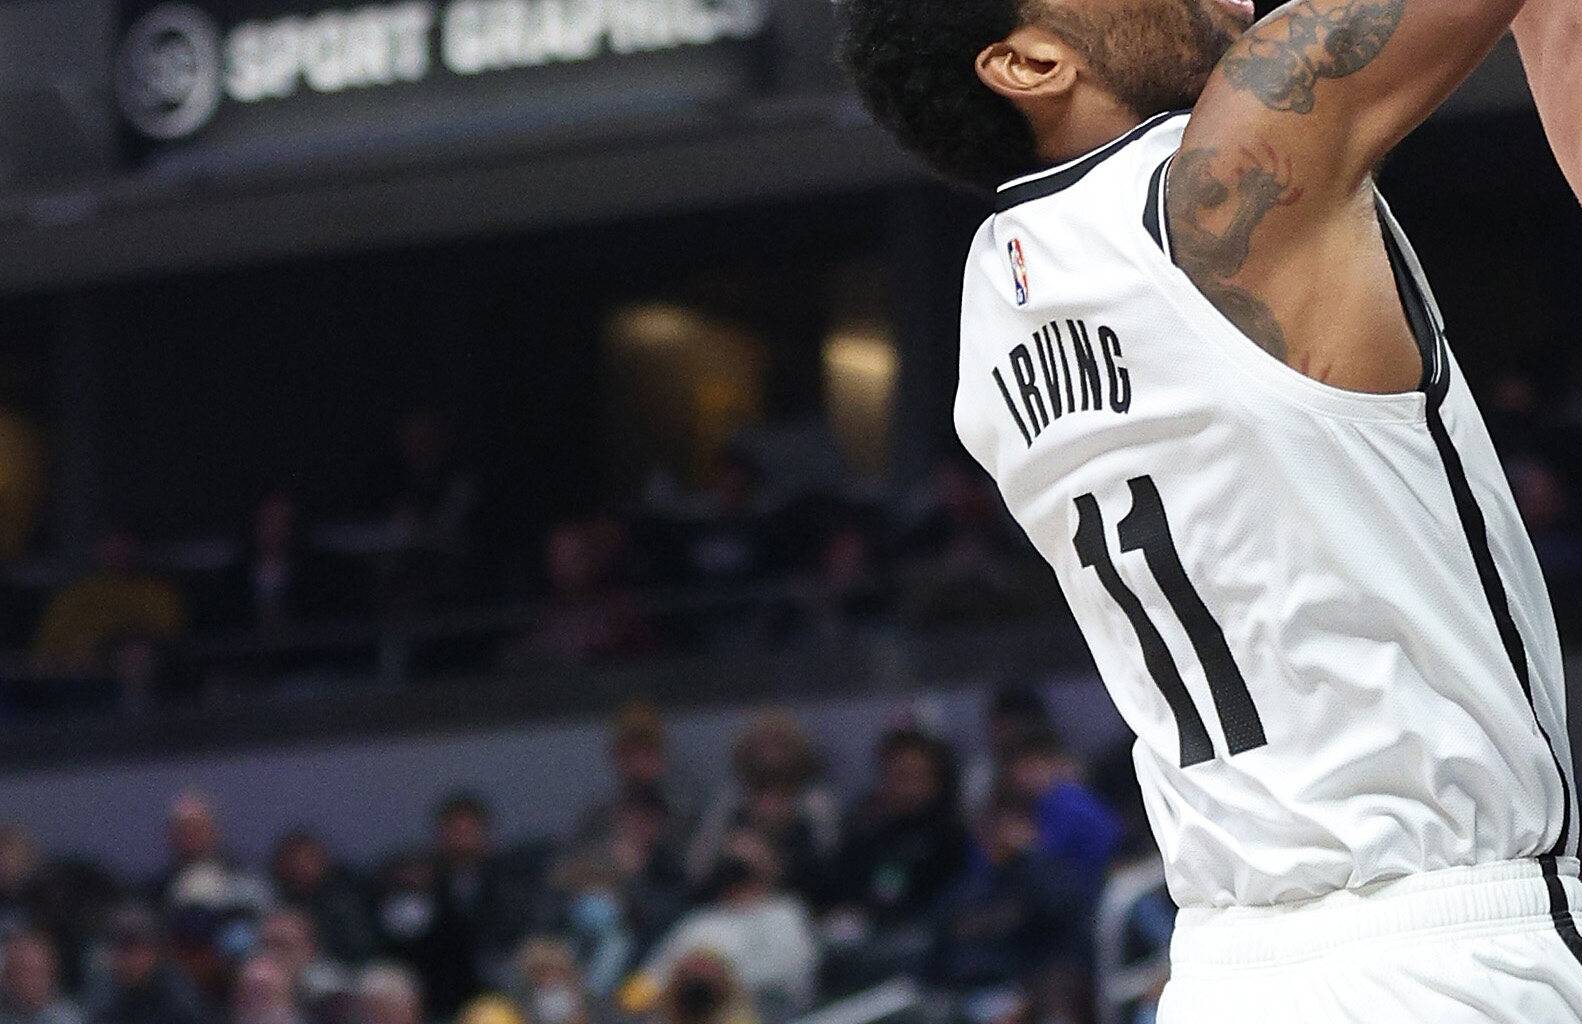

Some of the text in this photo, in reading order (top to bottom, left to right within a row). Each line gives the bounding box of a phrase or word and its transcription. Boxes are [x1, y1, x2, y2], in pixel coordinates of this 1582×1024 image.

[226, 0, 434, 100] SPORT
[992, 318, 1132, 449] IRVING
[1071, 474, 1269, 770] 11
